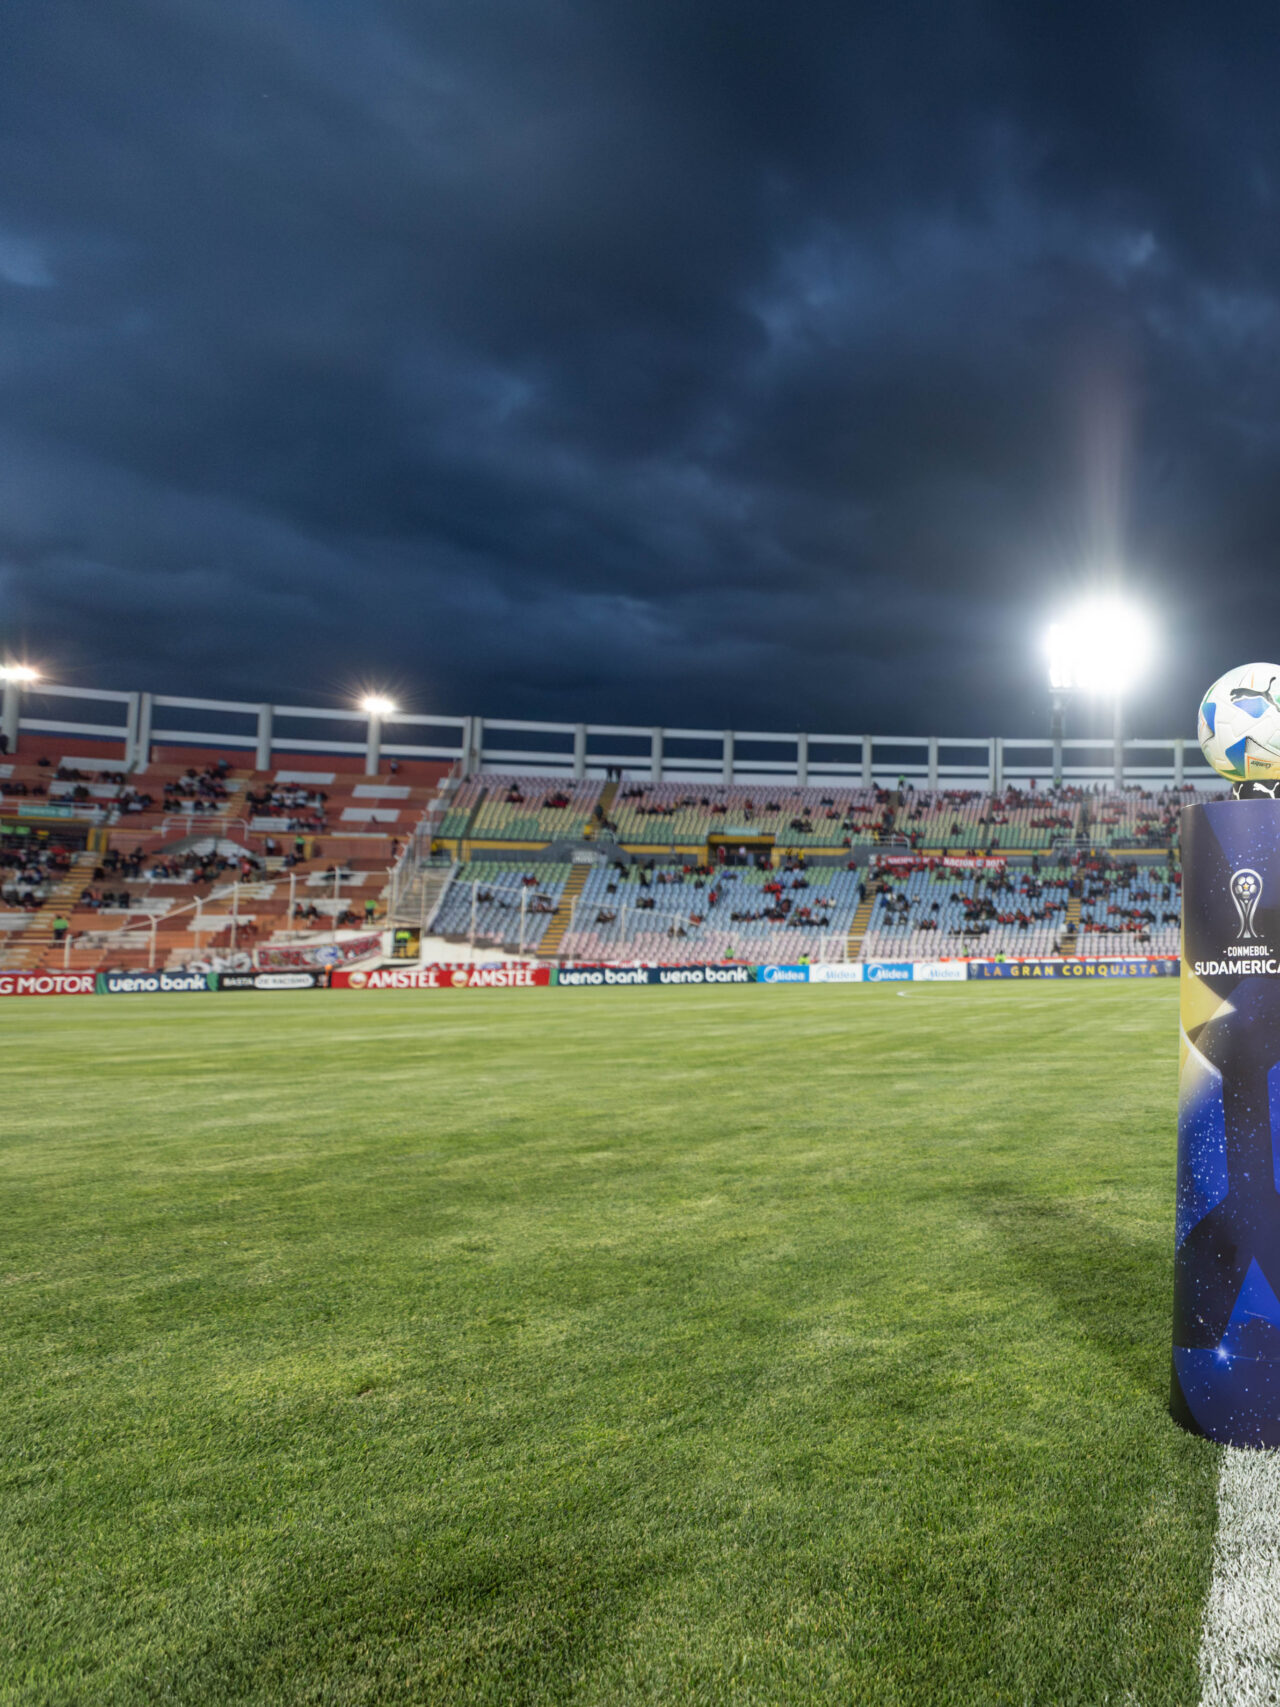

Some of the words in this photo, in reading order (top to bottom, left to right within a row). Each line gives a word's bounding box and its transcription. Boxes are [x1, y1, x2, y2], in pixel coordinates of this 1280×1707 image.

[368, 970, 439, 987] AMSTEL
[468, 970, 535, 986] AMSTEL
[559, 971, 601, 985] ueno
[604, 968, 648, 984] bank
[660, 969, 702, 983] ueno
[705, 967, 748, 982] bank
[773, 969, 806, 982] Midea
[826, 968, 857, 979] Midea
[877, 968, 909, 980] Midea
[928, 967, 960, 978] Midea
[984, 966, 1002, 976] LA
[1010, 966, 1054, 976] GRAN
[1062, 964, 1159, 977] CONQUISTA
[17, 975, 93, 993] MOTOR
[109, 975, 160, 991] ueno
[160, 972, 206, 990] bank
